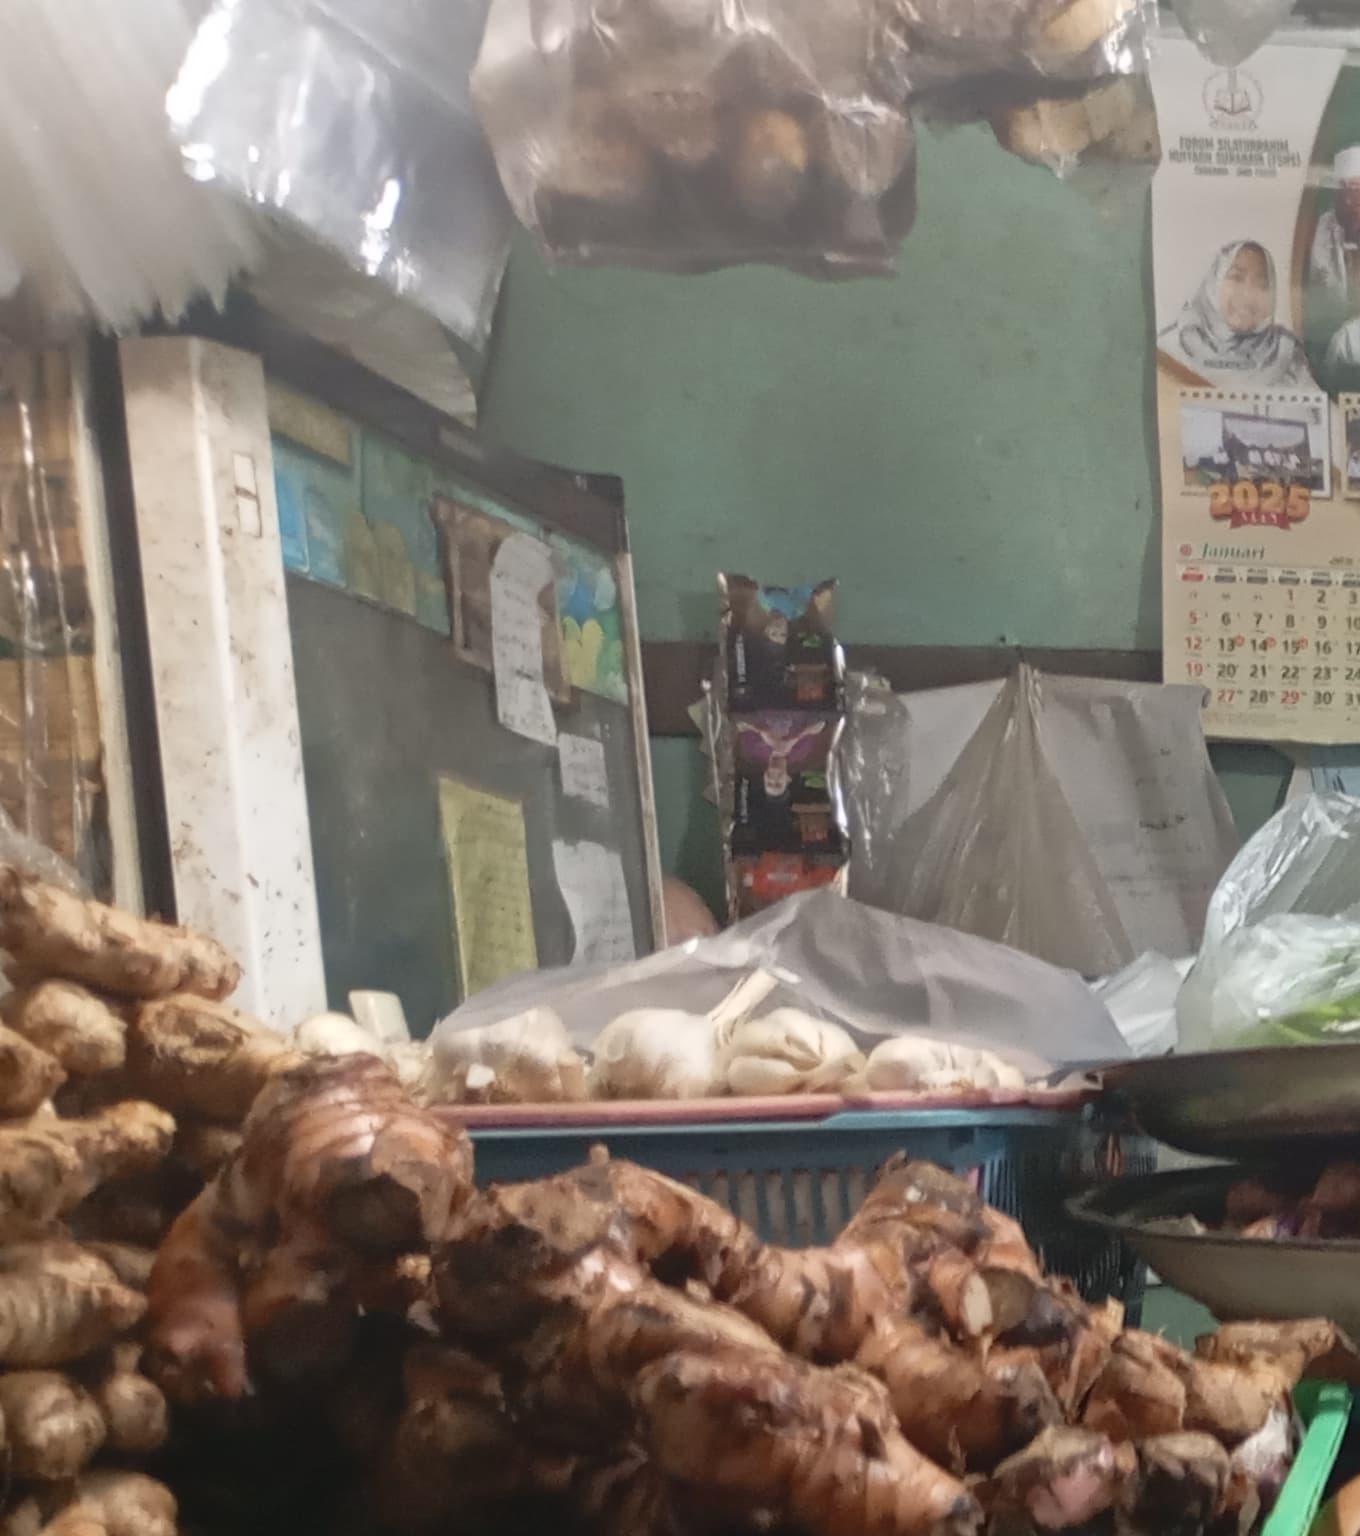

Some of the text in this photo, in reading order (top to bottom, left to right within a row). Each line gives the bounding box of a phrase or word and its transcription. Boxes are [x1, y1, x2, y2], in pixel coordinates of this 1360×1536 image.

[1210, 482, 1311, 522] 2025
[1202, 543, 1264, 559] Januari
[1288, 589, 1293, 601] 1
[1317, 590, 1326, 603] 2
[1350, 591, 1357, 604] 3
[1190, 611, 1197, 624] 5
[1222, 613, 1230, 625] 6
[1254, 613, 1262, 626] 7
[1286, 615, 1294, 628] 8
[1318, 616, 1327, 629] 9
[1186, 637, 1202, 650] 12
[1219, 638, 1236, 652] 13
[1251, 638, 1268, 651] 14
[1283, 640, 1300, 654] 15
[1315, 641, 1332, 654] 16
[1186, 662, 1203, 676] 19
[1218, 664, 1236, 677] 20
[1250, 664, 1266, 678] 21
[1282, 666, 1299, 679] 22
[1314, 667, 1331, 680] 23
[1218, 689, 1360, 705] 27 28 29 30 31
